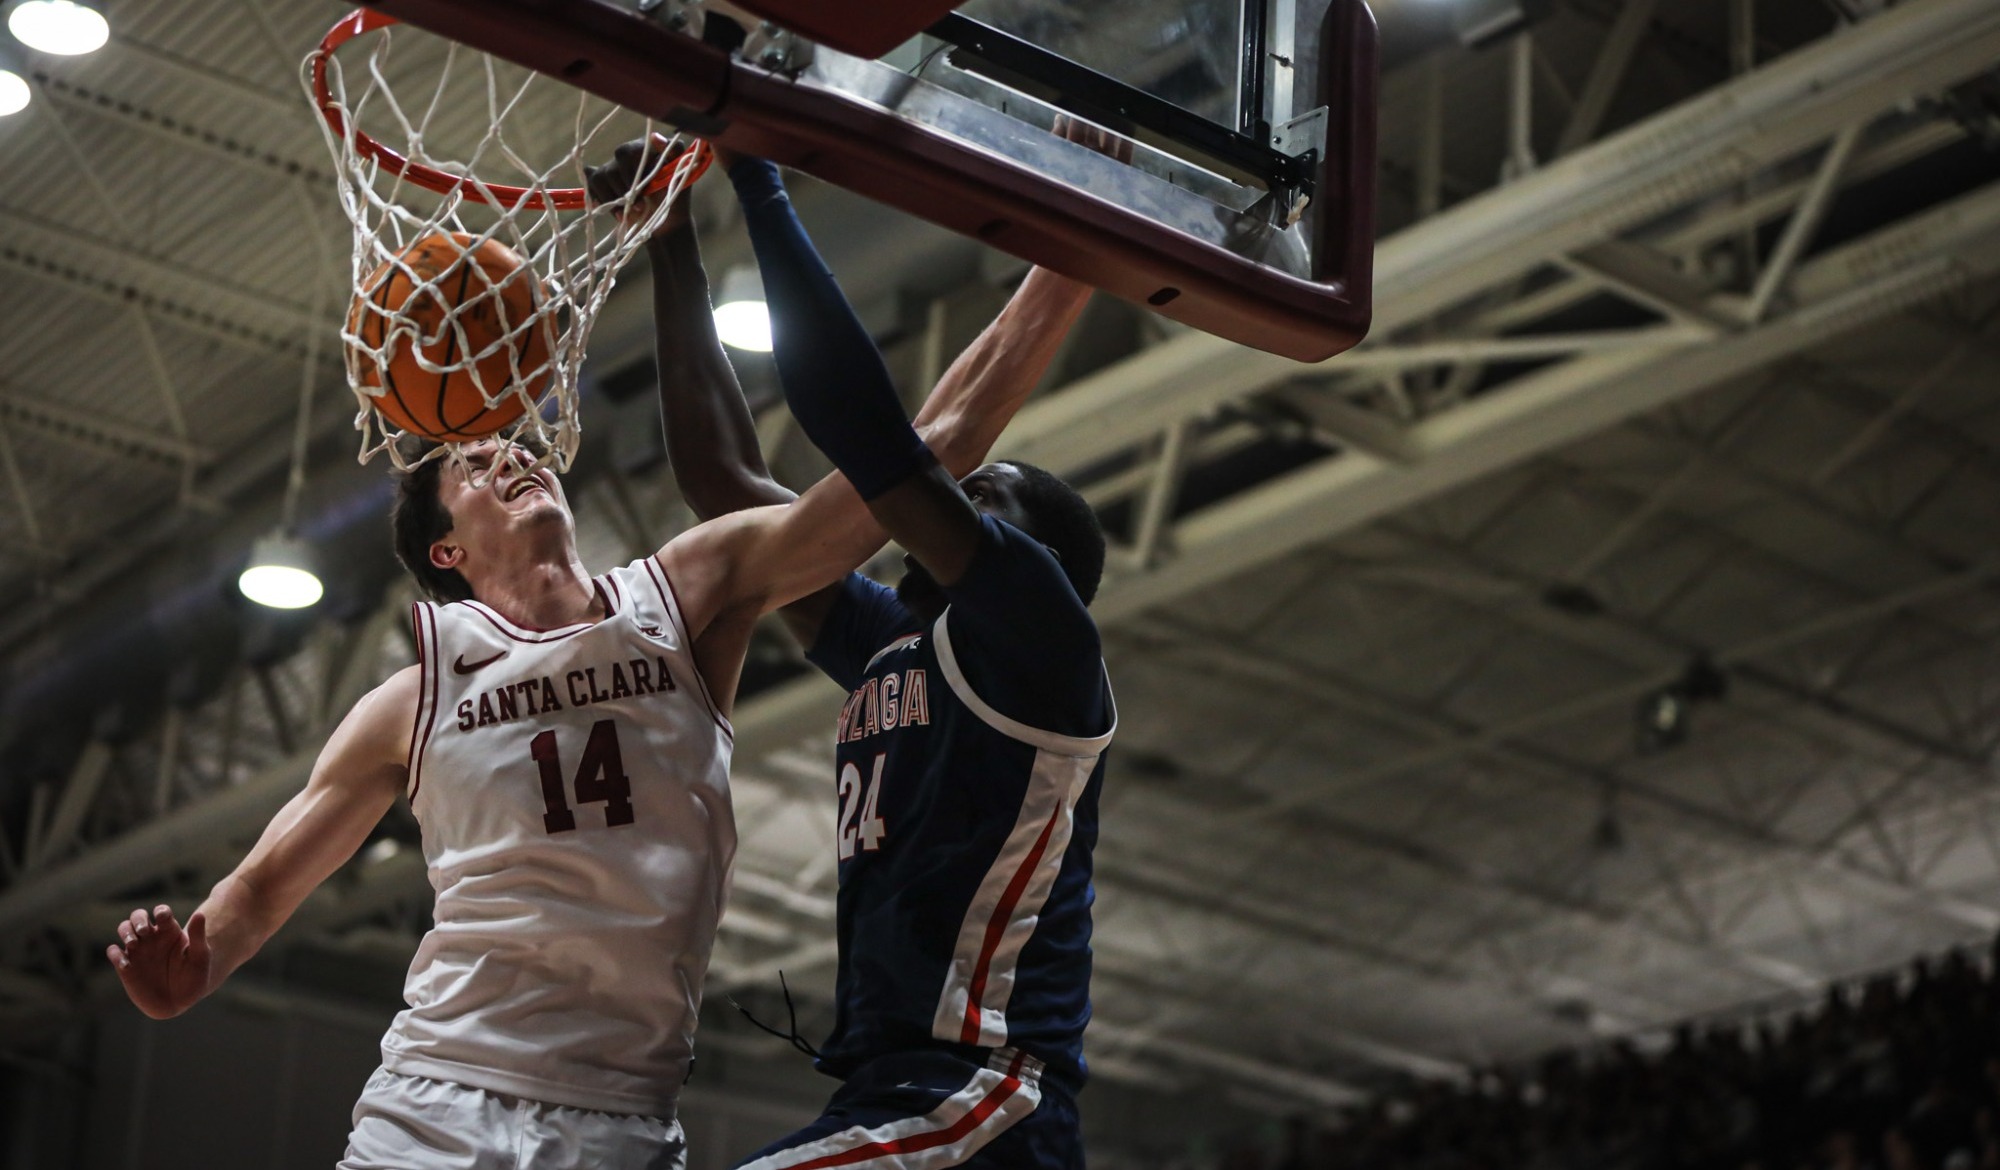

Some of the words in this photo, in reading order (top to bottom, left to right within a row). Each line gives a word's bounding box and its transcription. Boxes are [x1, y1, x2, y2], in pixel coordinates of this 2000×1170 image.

[457, 677, 563, 732] SANTA
[566, 656, 676, 707] CLARA
[530, 719, 634, 834] 14
[838, 753, 886, 861] 24
